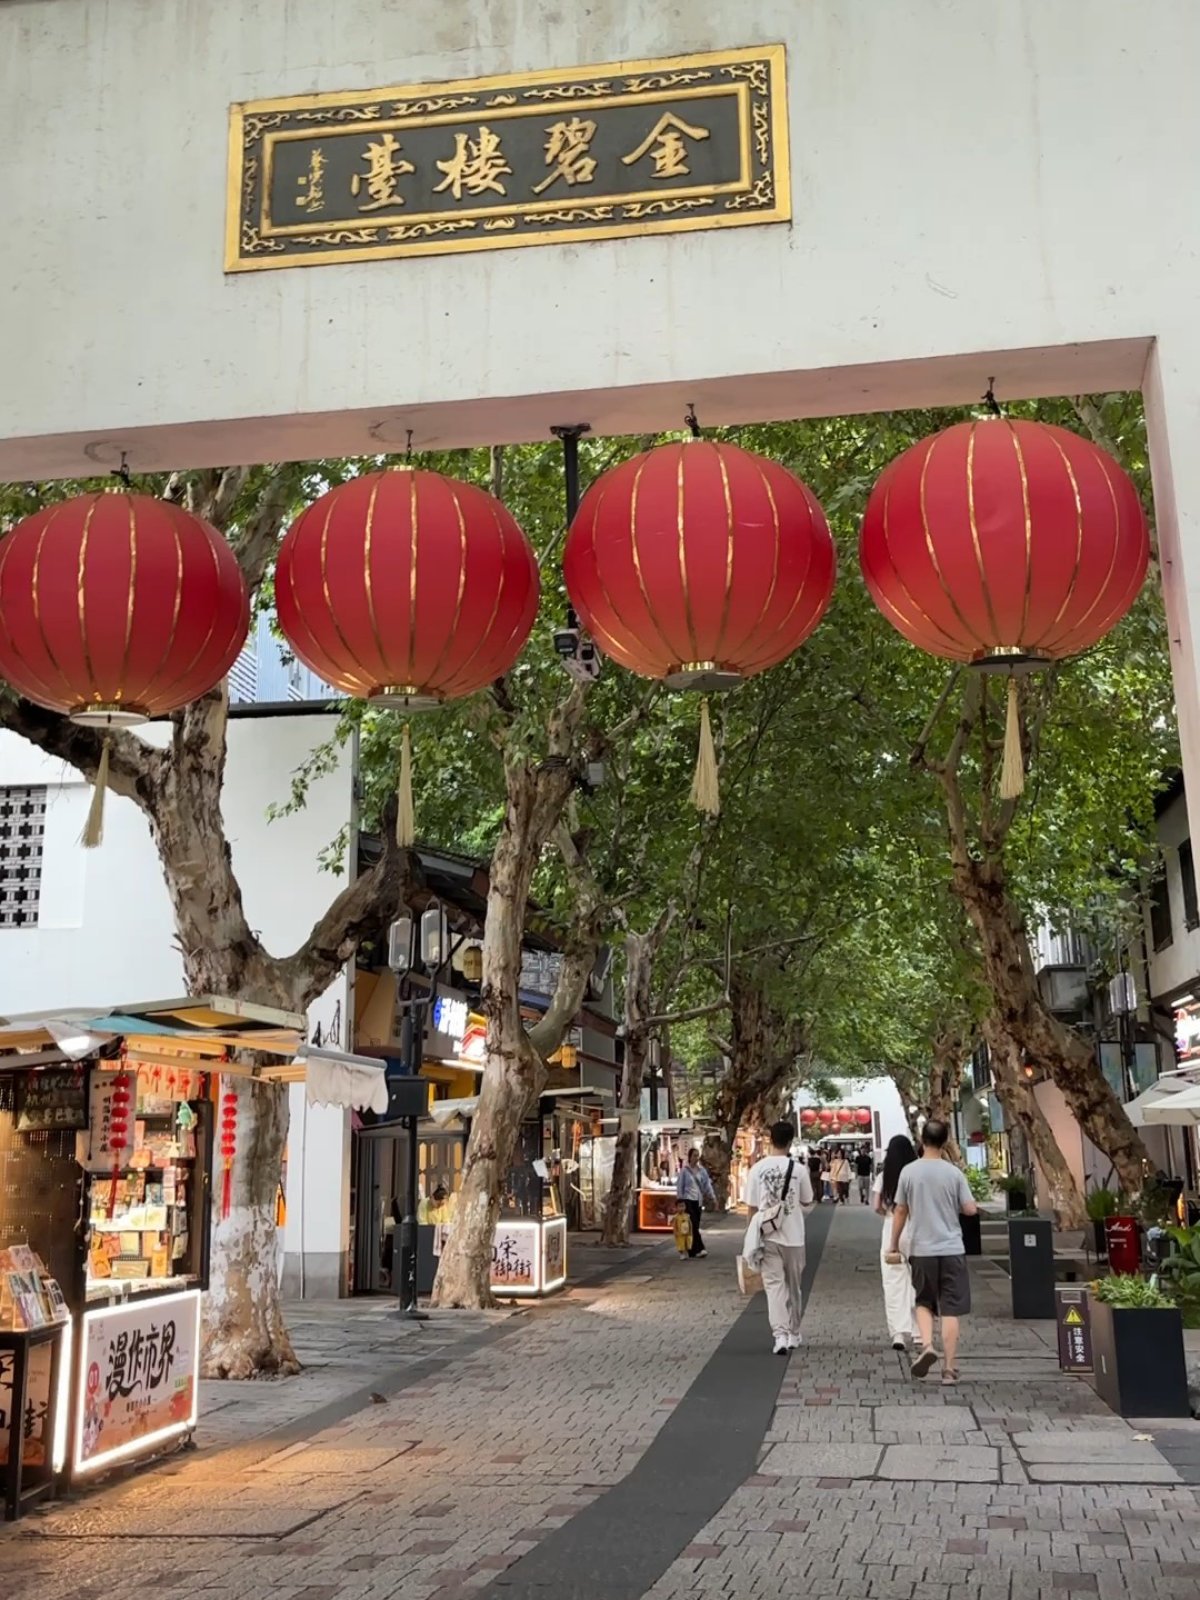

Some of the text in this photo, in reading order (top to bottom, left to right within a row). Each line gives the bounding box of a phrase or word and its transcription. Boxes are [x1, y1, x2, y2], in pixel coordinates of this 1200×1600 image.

[351, 110, 709, 213] 金碧樓臺
[1072, 1327, 1086, 1363] 注意安全
